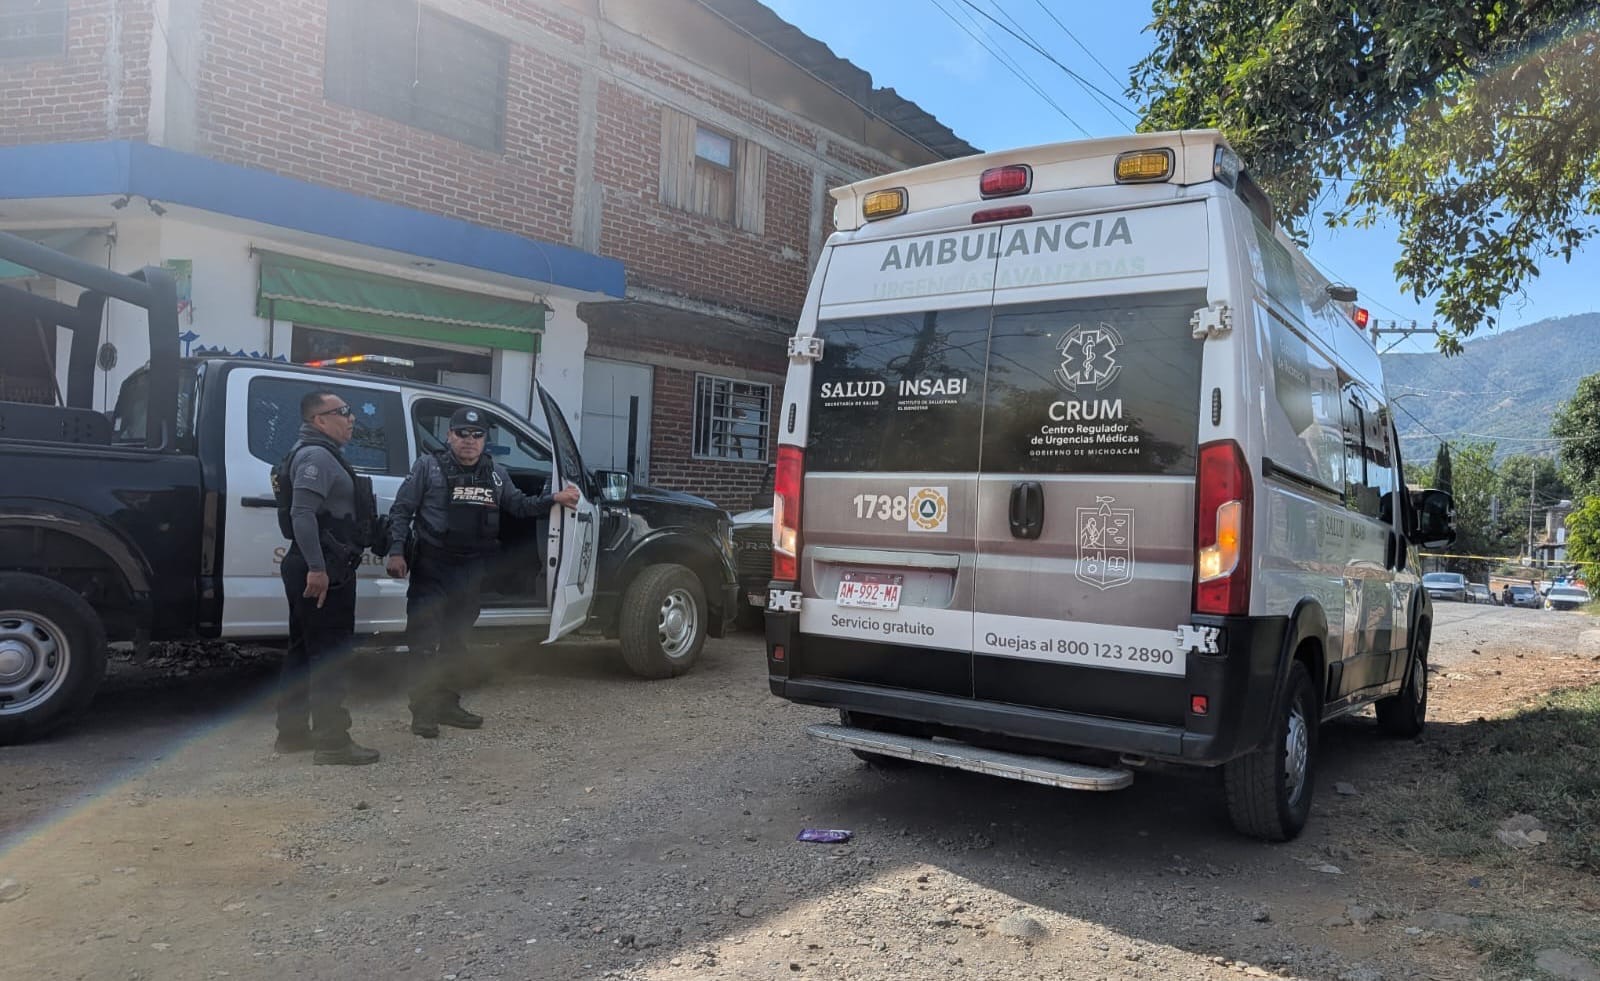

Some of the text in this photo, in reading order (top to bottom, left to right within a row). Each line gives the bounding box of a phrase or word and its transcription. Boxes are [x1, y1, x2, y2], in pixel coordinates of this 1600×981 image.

[880, 216, 1133, 271] AMBULANCIA
[873, 256, 1145, 296] URGENCIAS AVANZADAS
[820, 381, 885, 398] SALUD
[899, 378, 967, 396] INSABI
[1048, 399, 1122, 421] CRUM
[1041, 423, 1128, 435] Centro Regulador
[1031, 433, 1139, 446] de Urgencias Médicas
[453, 486, 493, 497] SSPC
[853, 494, 907, 521] 1738
[839, 583, 898, 602] AM-992-MA
[831, 614, 934, 636] Servicio gratuito
[985, 632, 1173, 664] Quejas al 800 123 2890
